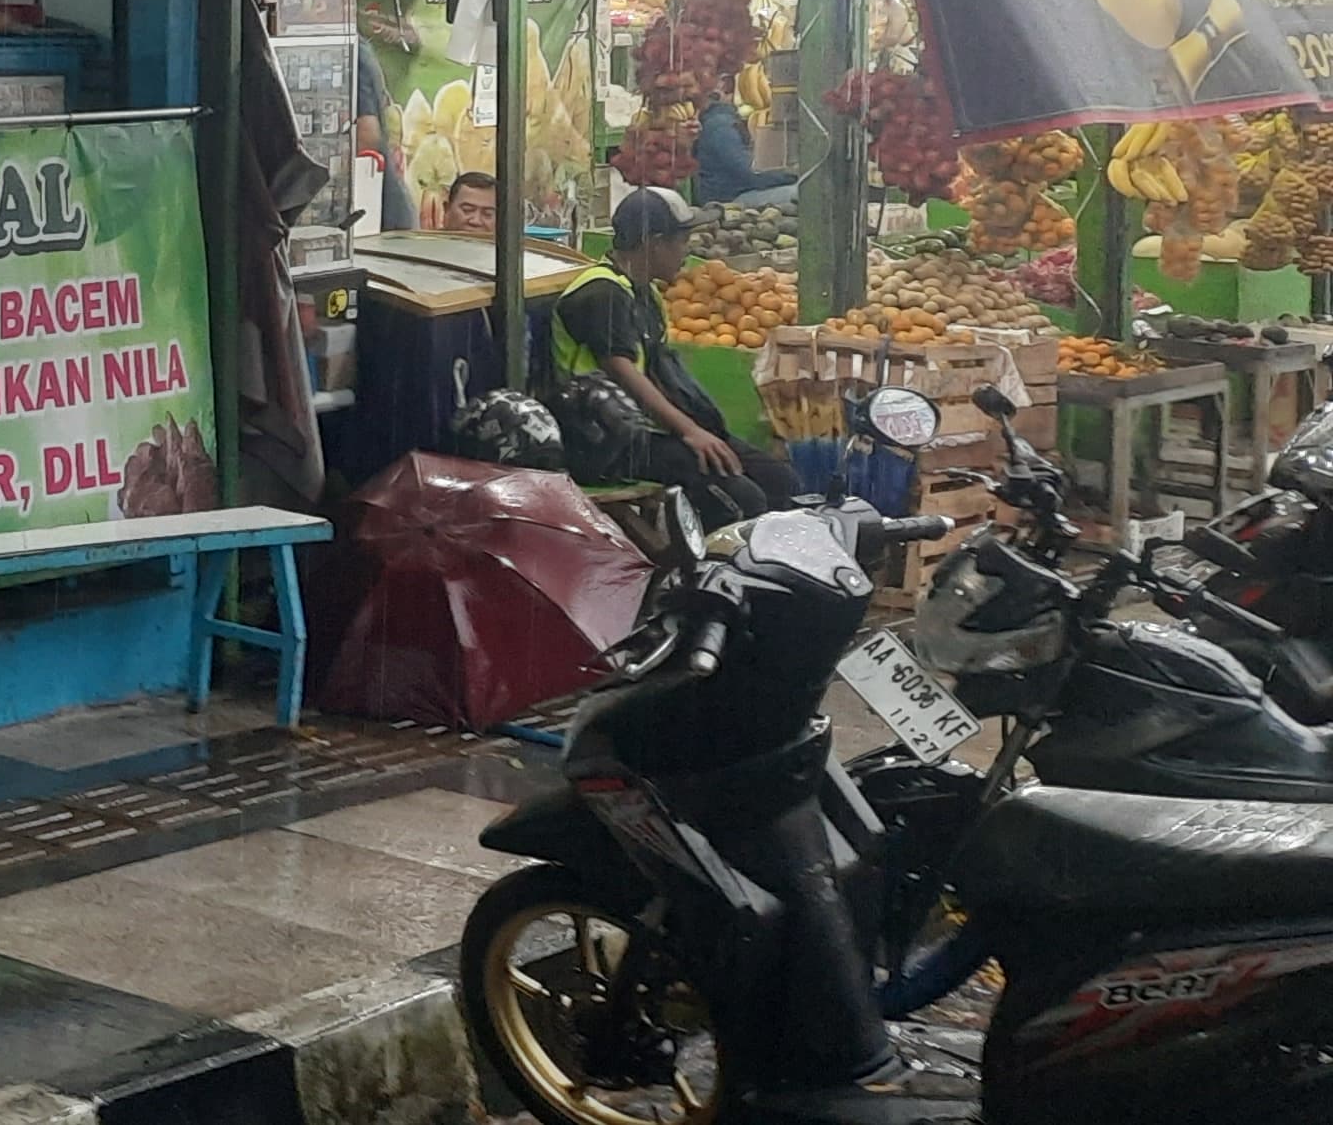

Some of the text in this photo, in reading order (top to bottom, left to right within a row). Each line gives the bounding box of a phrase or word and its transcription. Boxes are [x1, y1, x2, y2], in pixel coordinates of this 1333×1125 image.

[0, 278, 140, 339] BACEM
[103, 344, 186, 400] NILA
[43, 439, 121, 495] DLL
[863, 638, 897, 666] AA
[933, 710, 972, 737] KF
